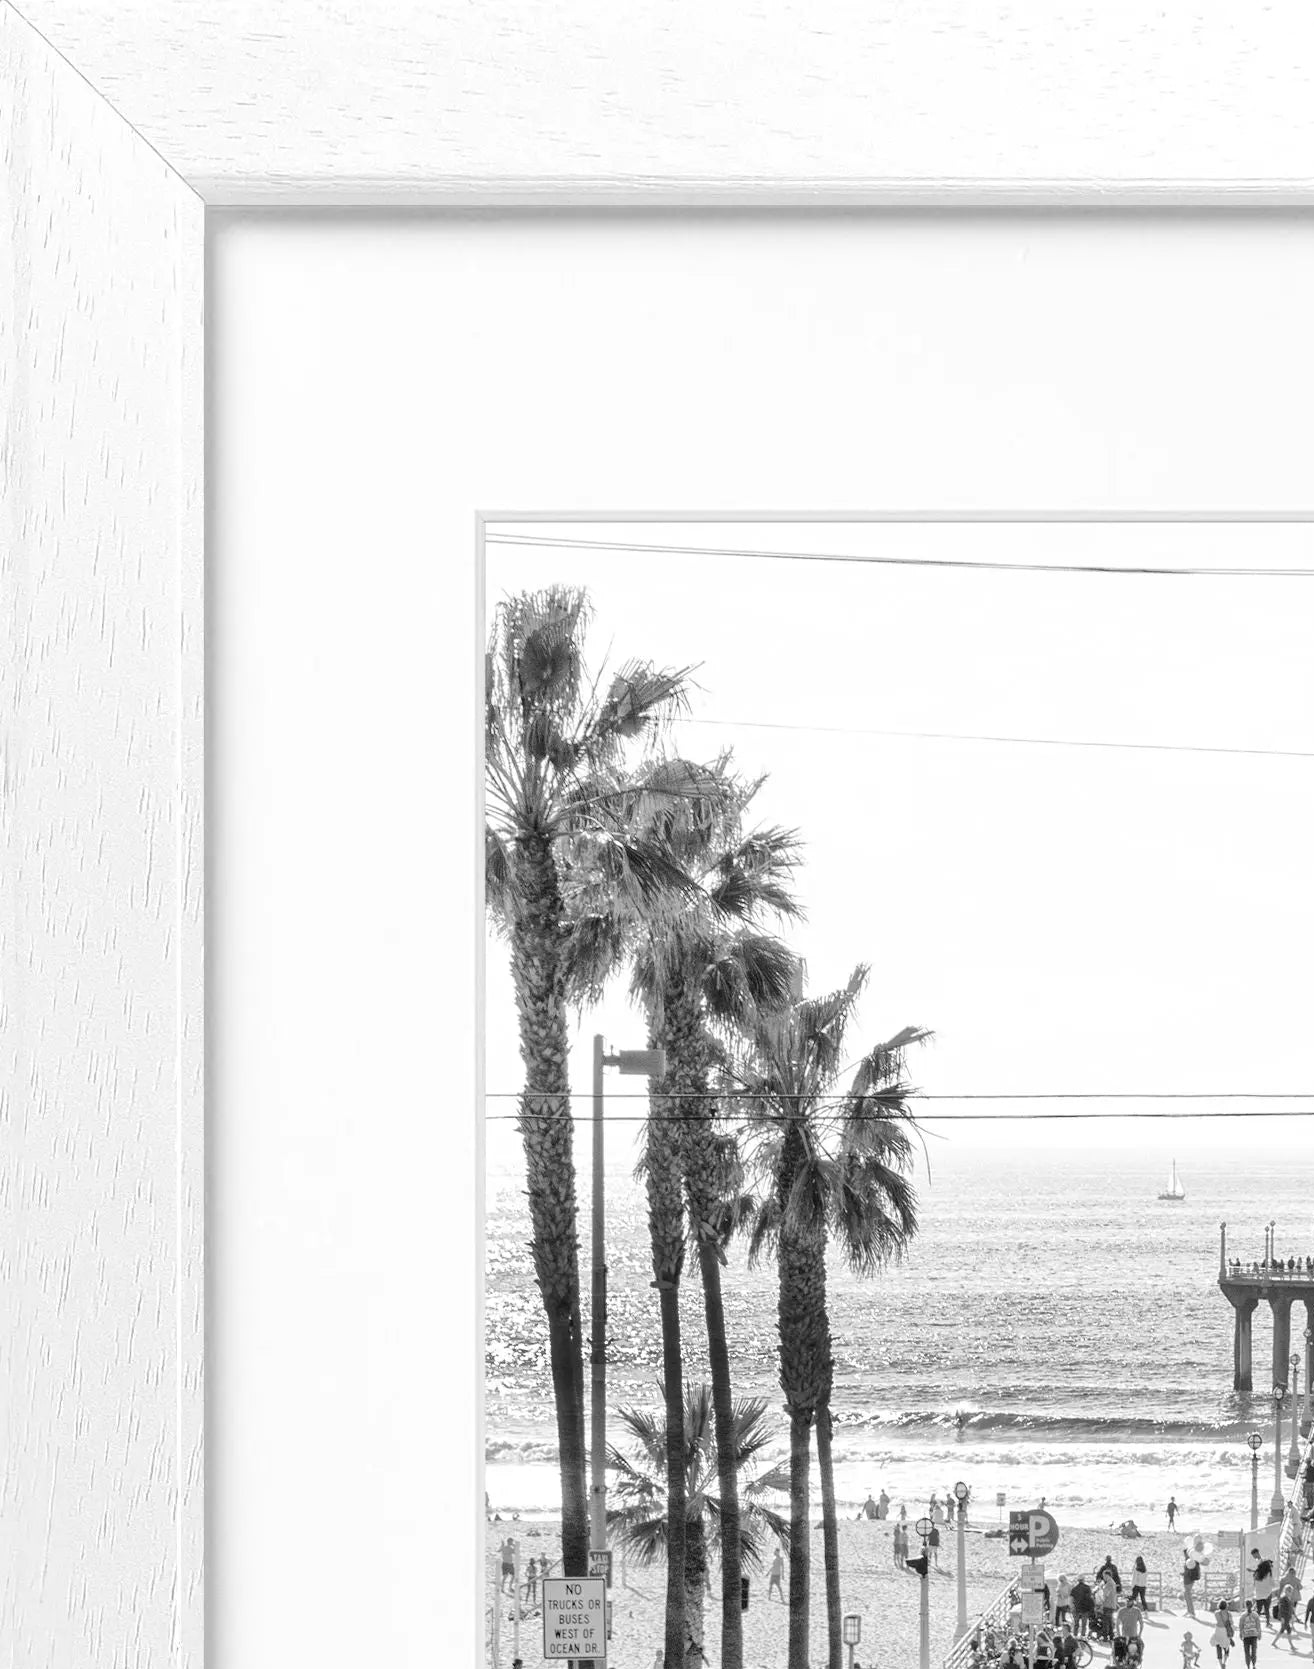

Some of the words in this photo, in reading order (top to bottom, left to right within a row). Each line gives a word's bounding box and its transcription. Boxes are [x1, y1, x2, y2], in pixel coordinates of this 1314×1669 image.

[1029, 1515, 1051, 1548] P
[565, 1584, 582, 1596] NO
[548, 1599, 584, 1610] TRUCKS
[588, 1599, 601, 1610] OR
[559, 1614, 590, 1625] BUSES
[554, 1628, 579, 1639] WEST
[583, 1628, 595, 1639] OF
[550, 1643, 580, 1654] OCEAN
